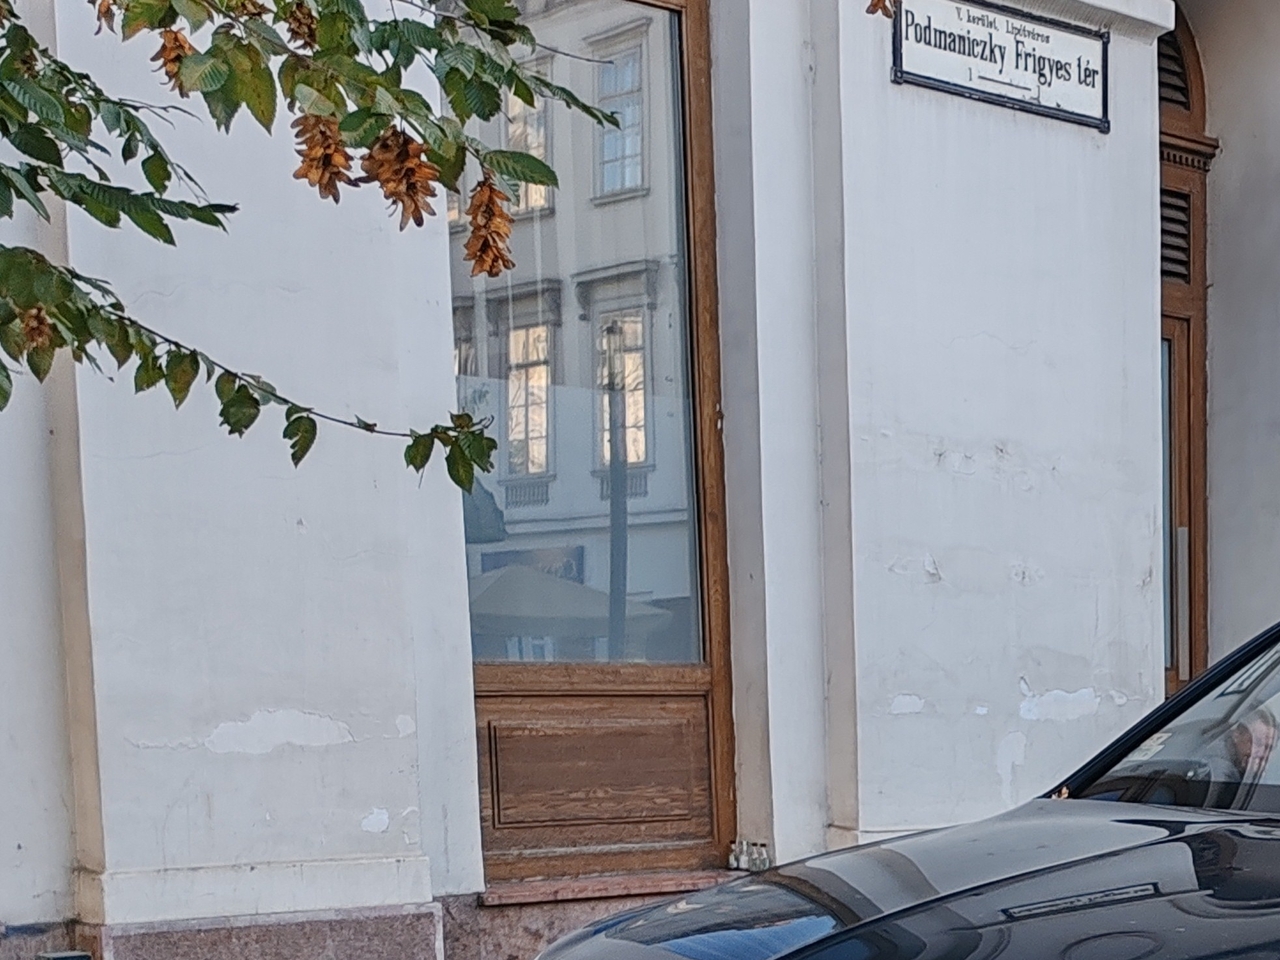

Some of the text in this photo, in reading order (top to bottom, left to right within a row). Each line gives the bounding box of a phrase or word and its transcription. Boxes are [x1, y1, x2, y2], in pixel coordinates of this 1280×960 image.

[955, 6, 963, 21] V.
[904, 9, 1099, 88] Podmaniczky Frigyes tér
